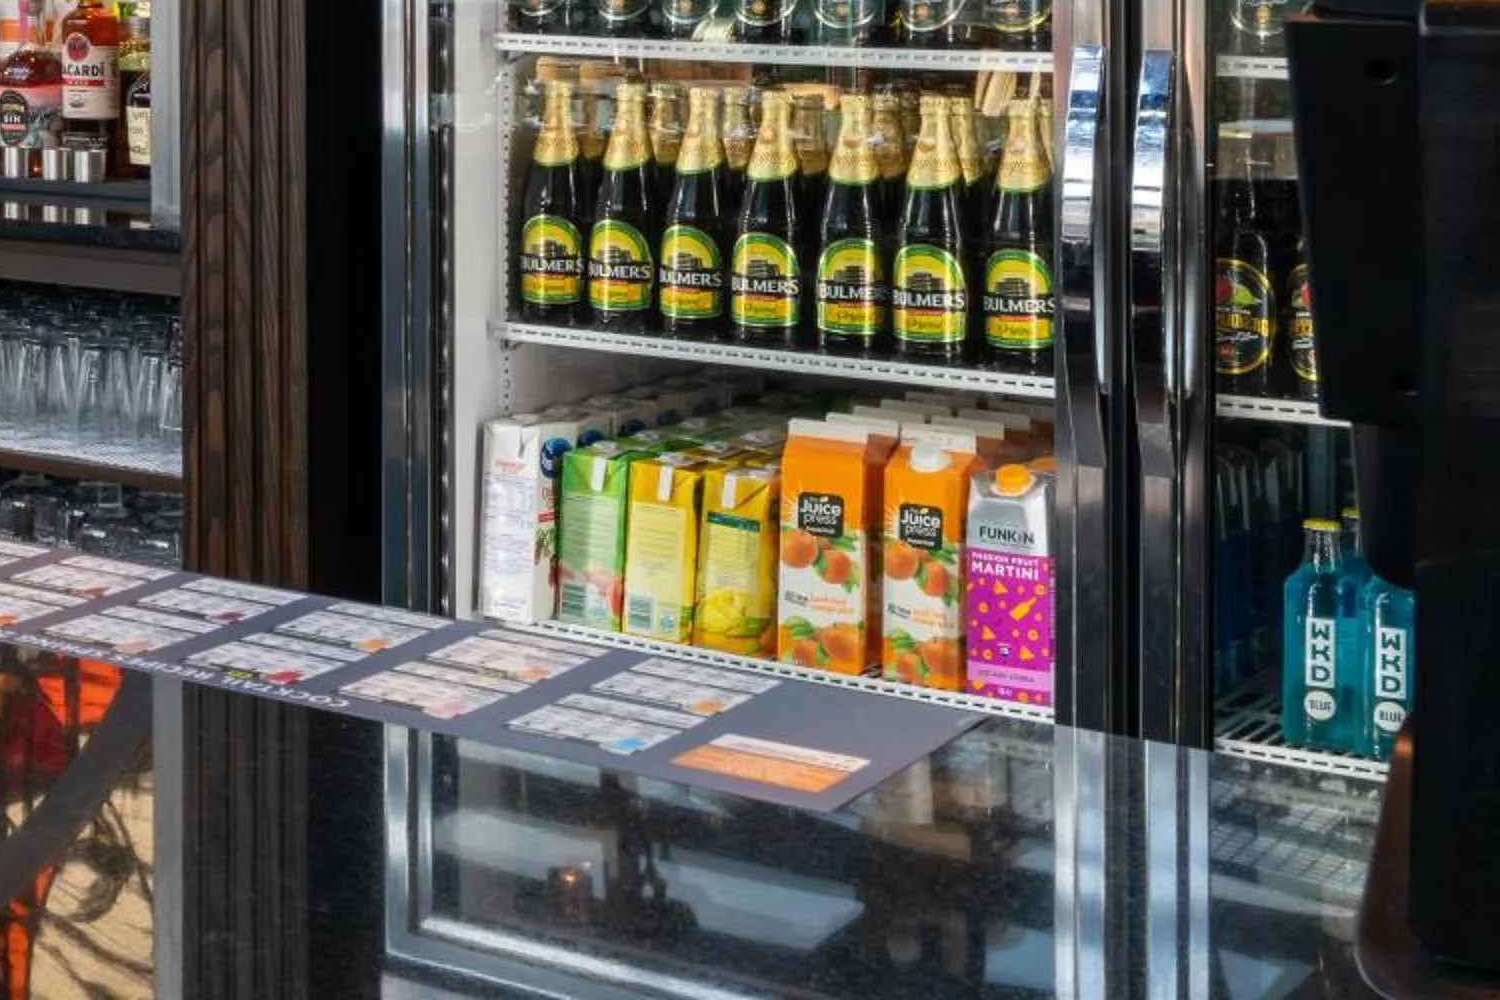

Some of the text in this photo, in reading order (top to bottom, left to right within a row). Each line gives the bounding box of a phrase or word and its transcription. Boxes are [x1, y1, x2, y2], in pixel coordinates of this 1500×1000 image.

[819, 282, 885, 299] BULME
[984, 295, 1056, 313] BULMERS
[800, 499, 841, 517] Juice
[803, 513, 837, 526] press
[901, 510, 941, 528] Juice
[979, 526, 1035, 545] FUNKIN
[971, 560, 1040, 581] MARTINI
[1311, 622, 1331, 683] WKD
[1380, 631, 1402, 693] WKD
